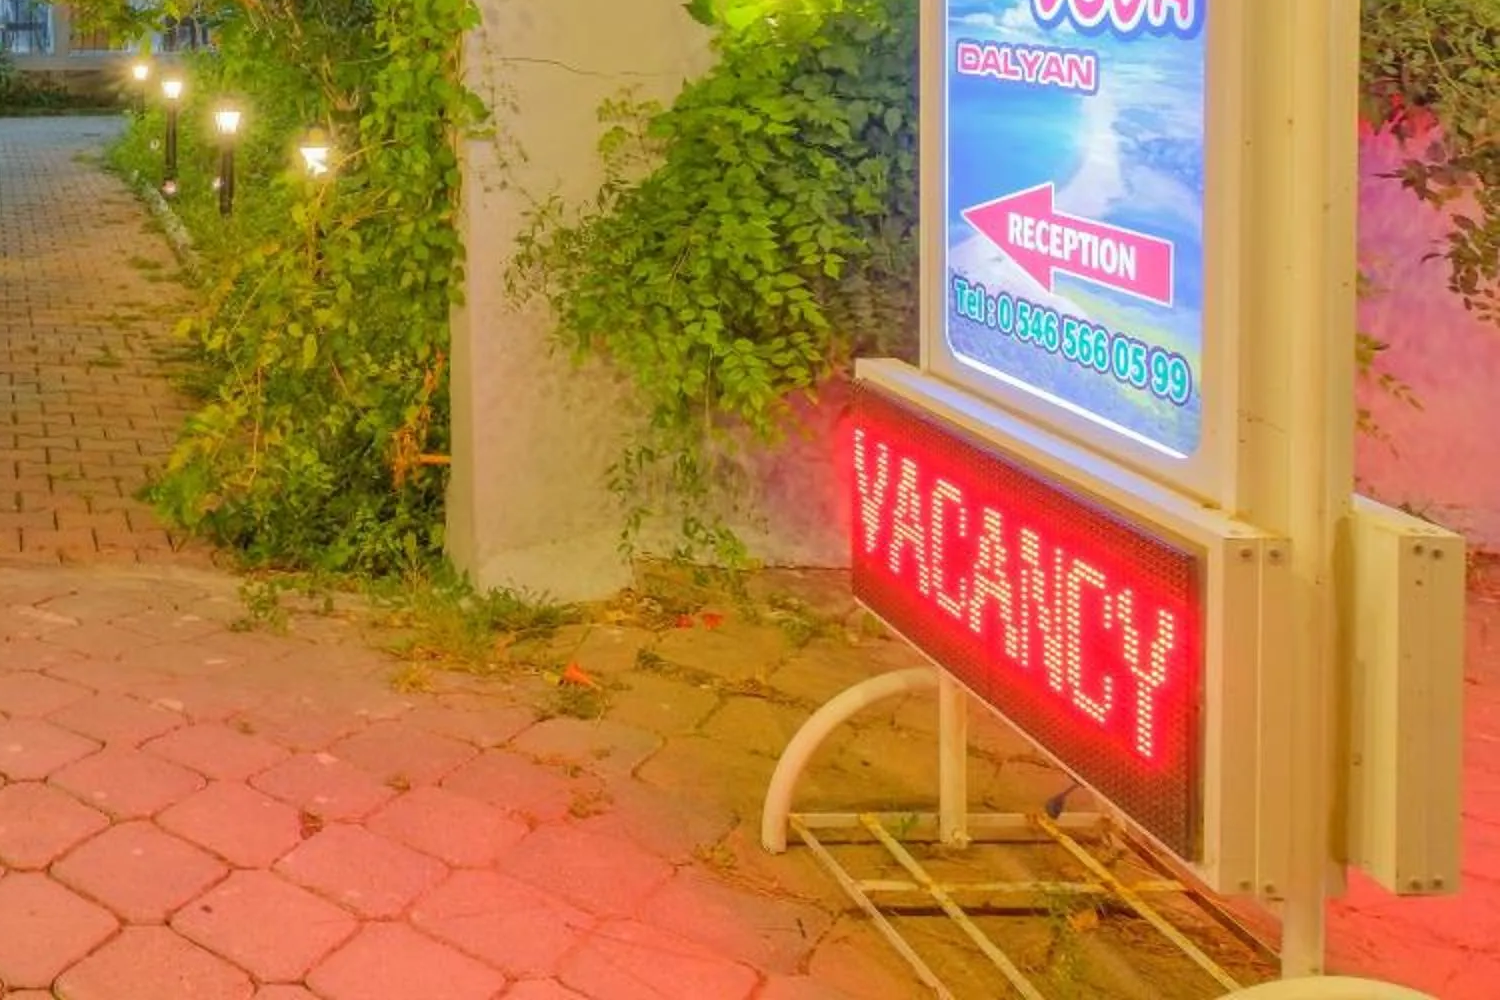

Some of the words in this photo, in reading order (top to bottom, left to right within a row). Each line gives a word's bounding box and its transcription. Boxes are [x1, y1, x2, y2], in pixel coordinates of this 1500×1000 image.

[957, 43, 1096, 92] DALYAN
[1007, 212, 1137, 281] RECEPTION
[853, 428, 1174, 758] VACANCY
